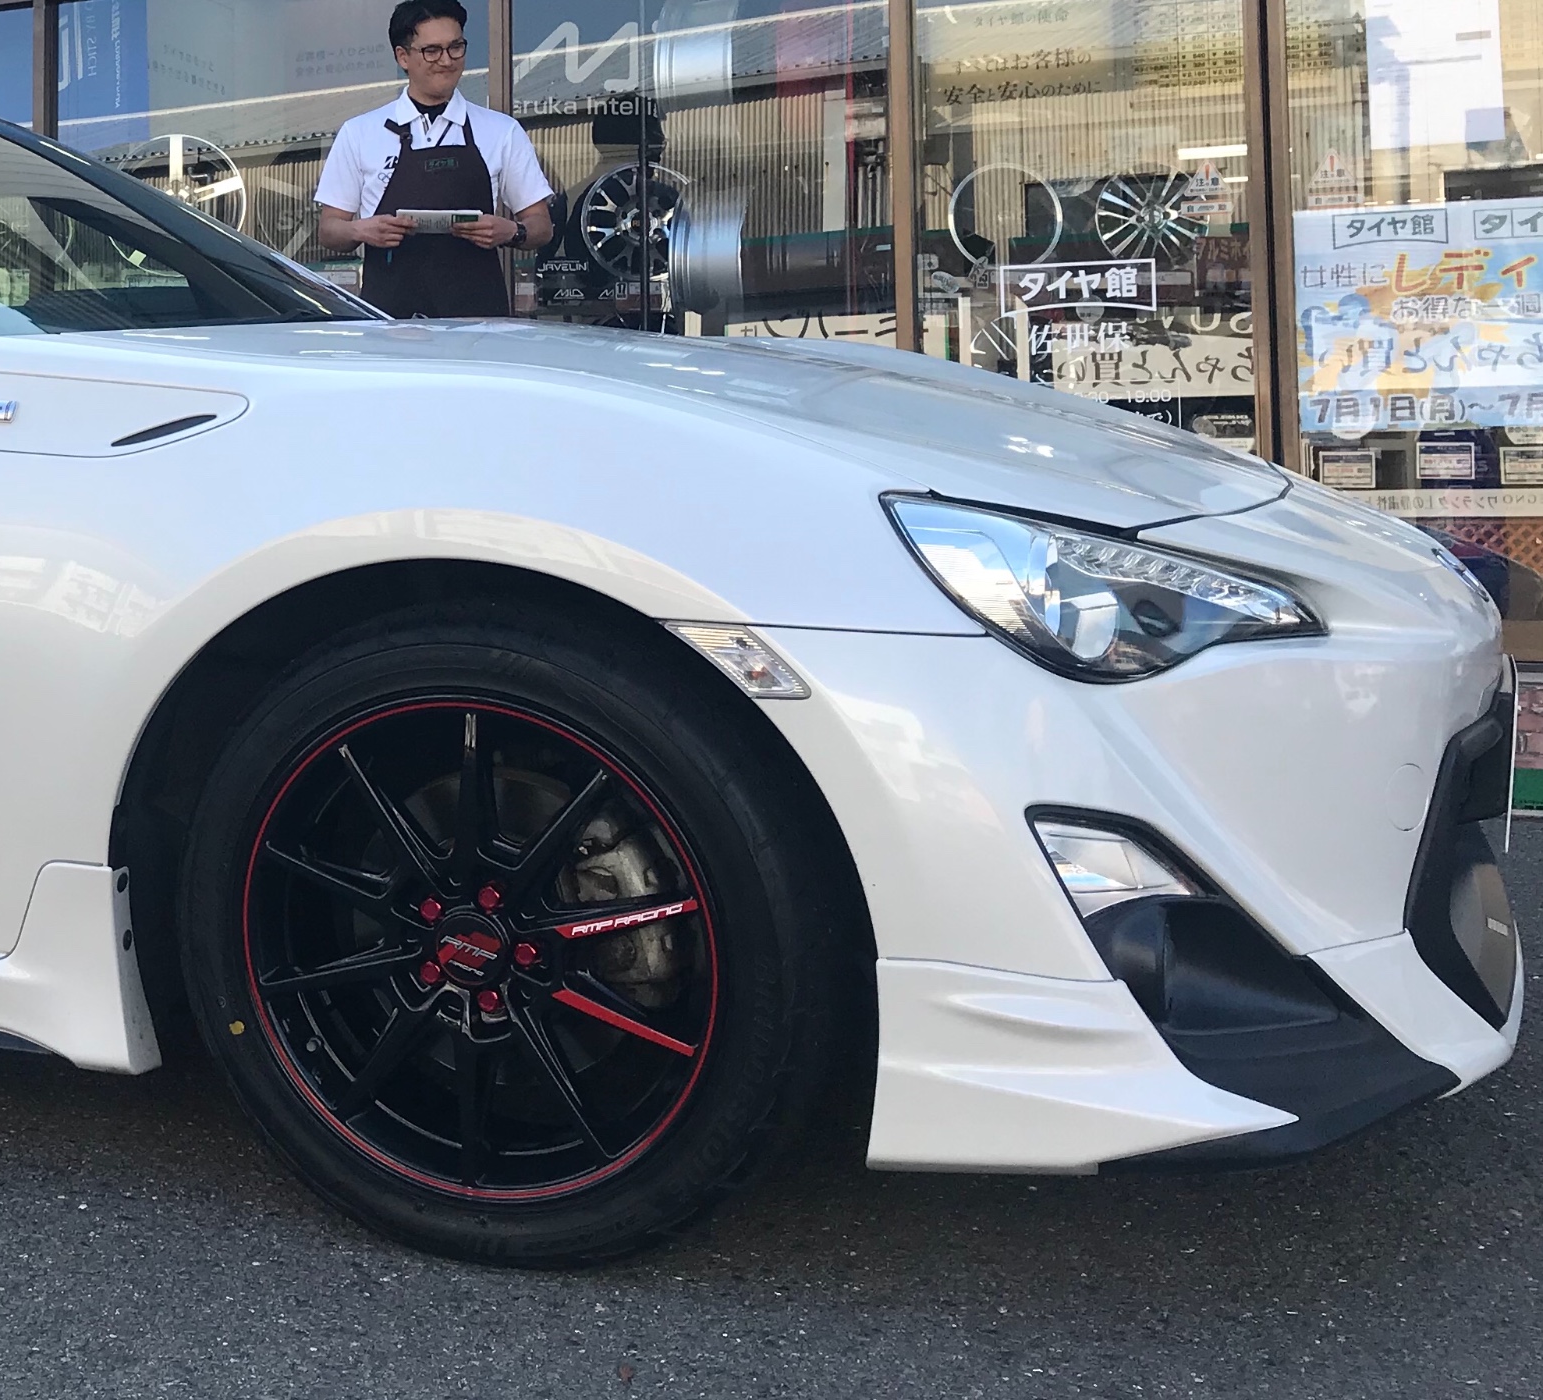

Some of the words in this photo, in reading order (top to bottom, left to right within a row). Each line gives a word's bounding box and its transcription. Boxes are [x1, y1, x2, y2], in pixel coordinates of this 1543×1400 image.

[944, 81, 1103, 105] 安全と安心のために
[1346, 213, 1435, 239] タイヤ館
[537, 262, 588, 272] JAVELIN
[1392, 250, 1536, 294] レディ
[1018, 266, 1139, 301] タイヤ館
[1027, 321, 1131, 355] 佐世保
[571, 920, 613, 936] RMP
[613, 903, 684, 928] RACING
[440, 935, 498, 961] RMP
